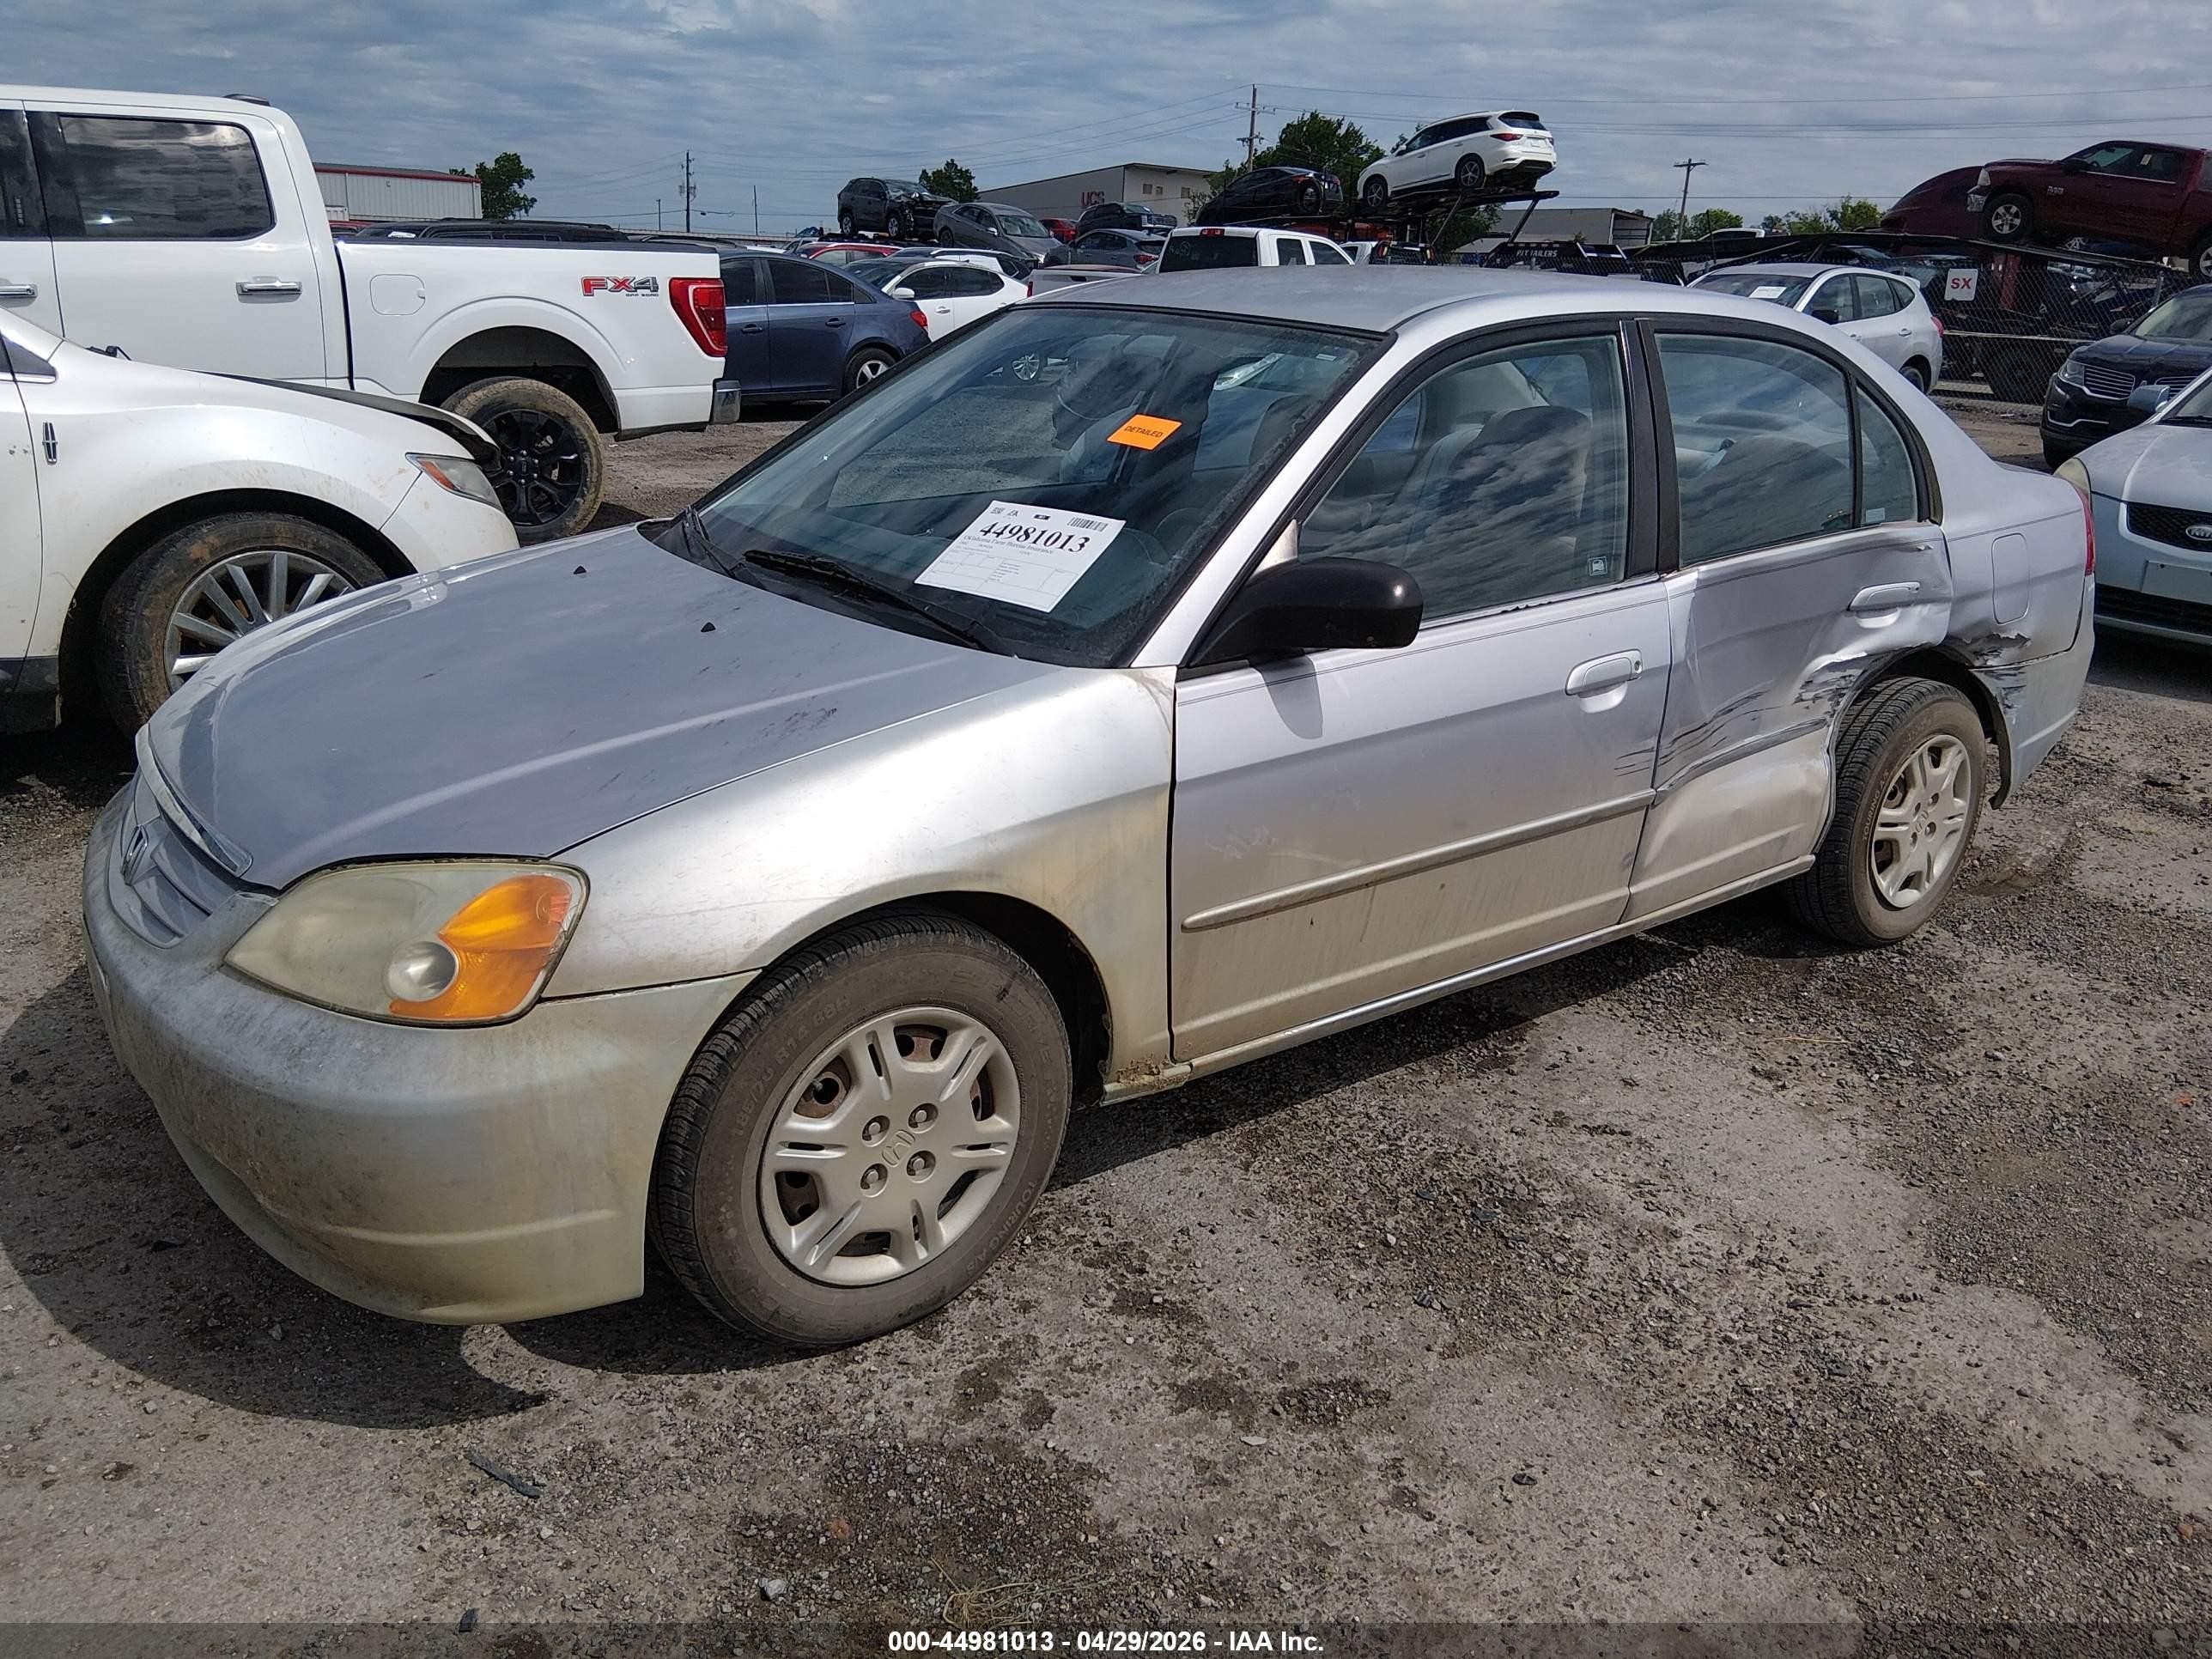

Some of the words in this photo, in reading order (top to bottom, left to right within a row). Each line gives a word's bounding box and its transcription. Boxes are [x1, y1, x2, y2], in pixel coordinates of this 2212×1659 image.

[581, 276, 659, 296] FX4
[1950, 277, 1972, 289] SX
[1125, 426, 1164, 438] DETAILED
[980, 522, 1091, 553] 44981013
[988, 1181, 1036, 1249] TOURING
